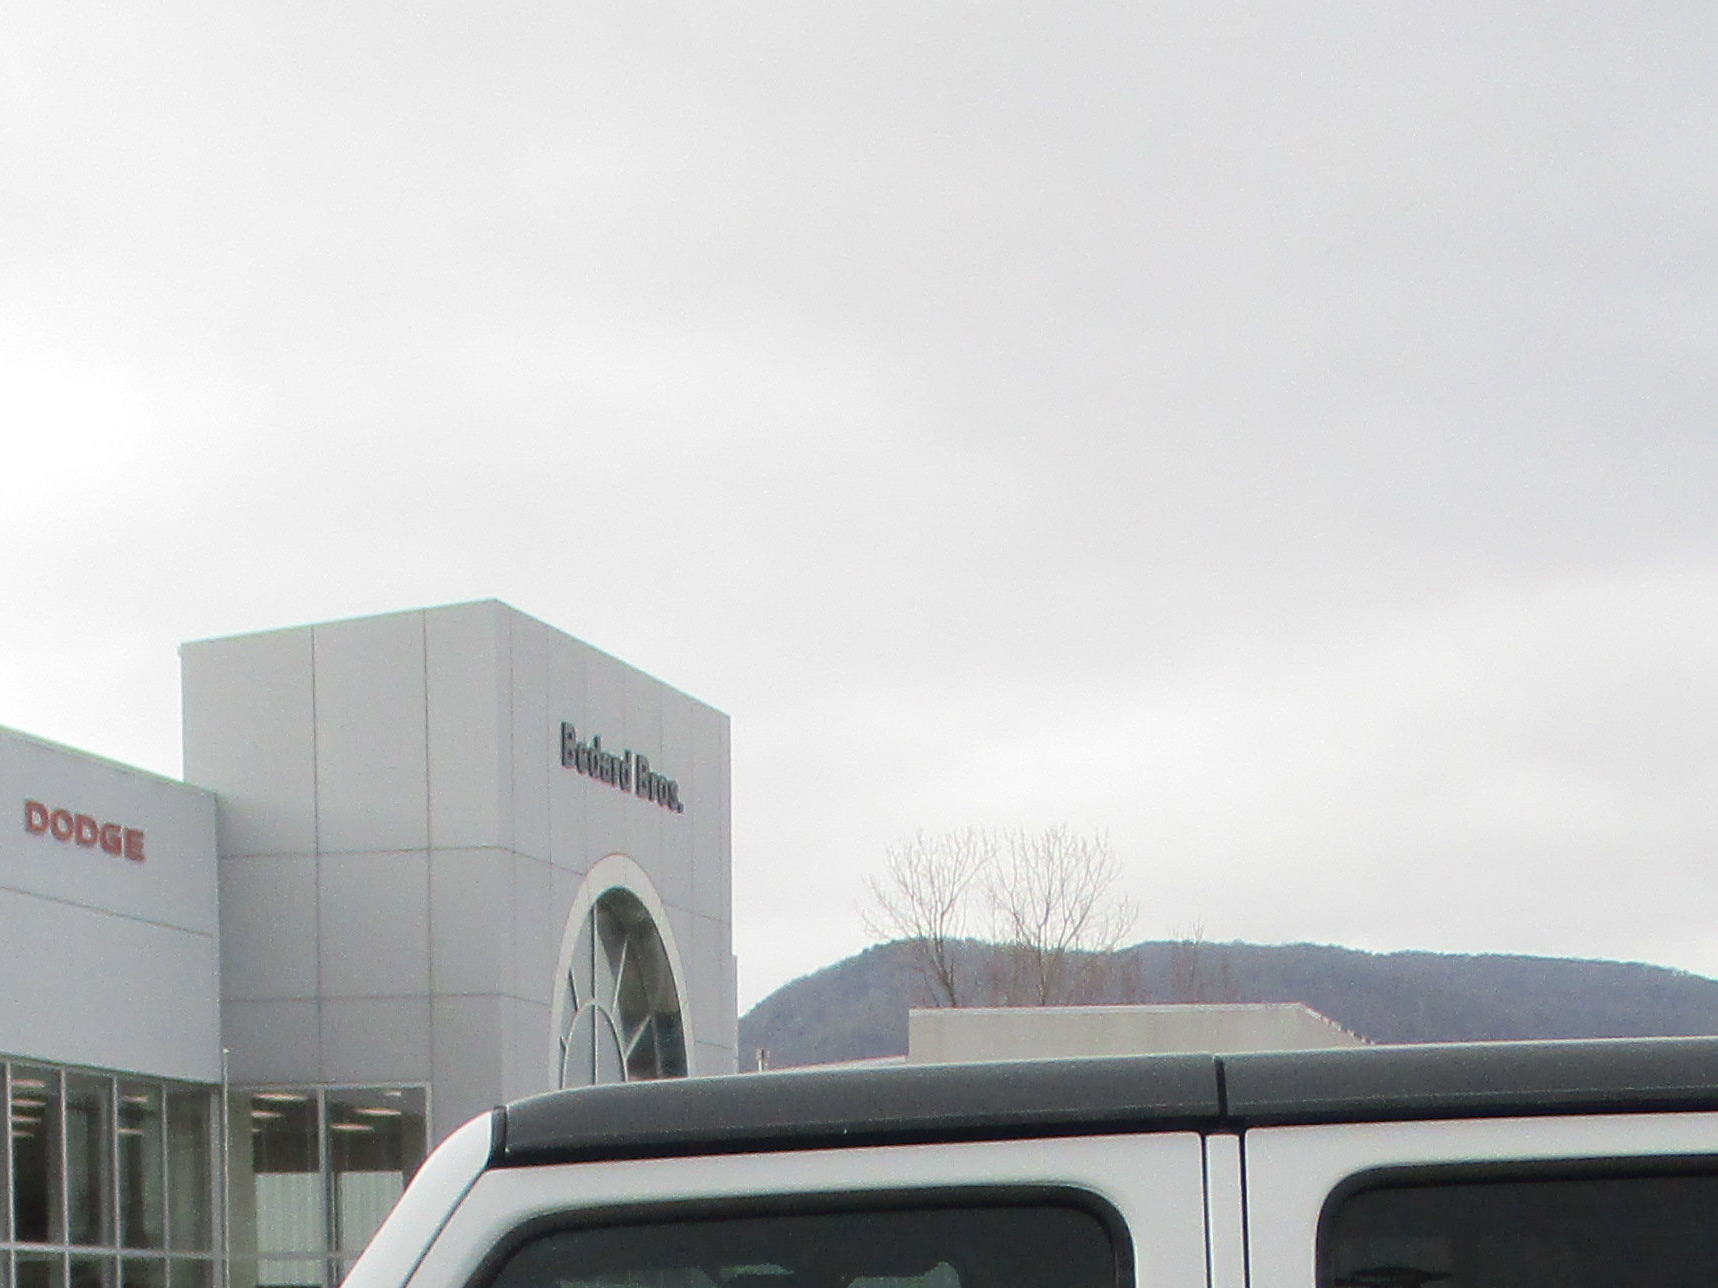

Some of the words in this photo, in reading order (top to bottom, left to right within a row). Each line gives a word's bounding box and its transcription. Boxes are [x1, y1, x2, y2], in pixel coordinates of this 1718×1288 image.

[561, 720, 632, 793] Bedard
[635, 753, 684, 814] Bros.
[24, 800, 146, 863] DODGE
